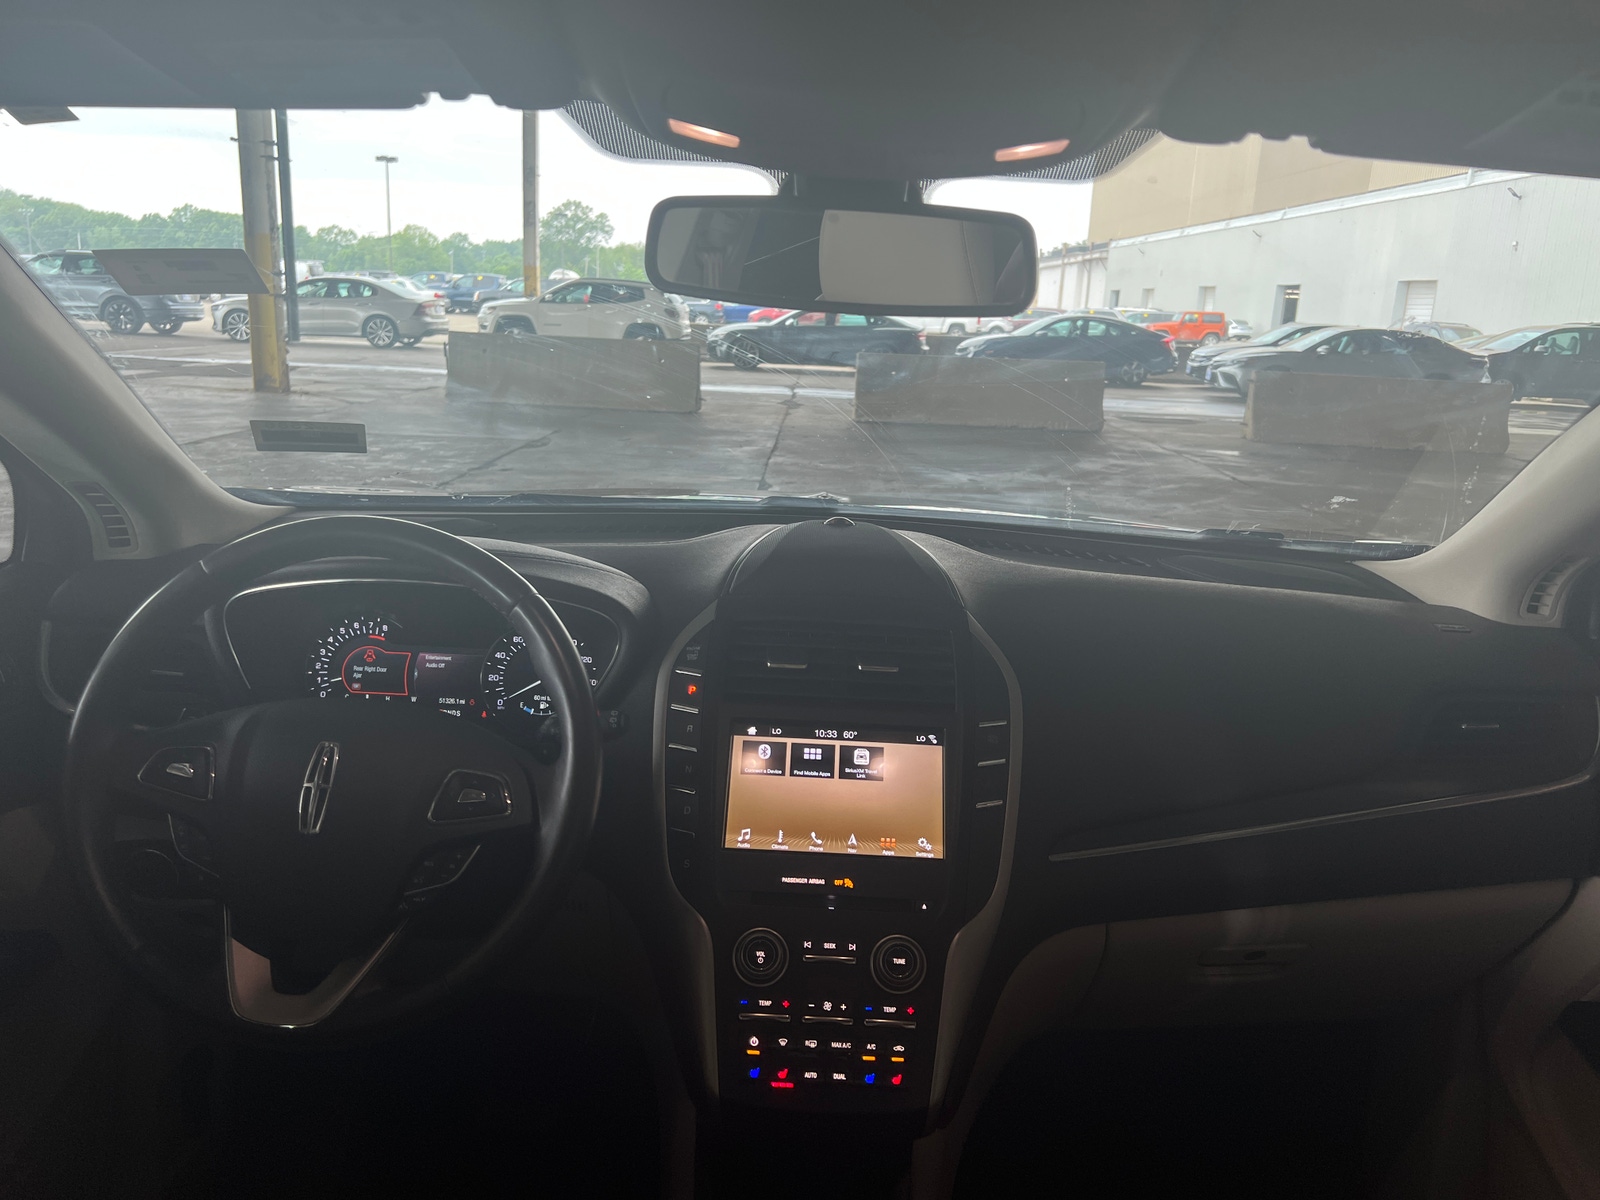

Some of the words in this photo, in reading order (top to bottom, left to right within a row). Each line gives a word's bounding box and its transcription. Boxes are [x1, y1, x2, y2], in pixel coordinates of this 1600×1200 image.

[688, 684, 697, 694] P
[686, 724, 694, 733] R
[814, 730, 838, 739] 10:33
[843, 730, 858, 739] 60°
[686, 765, 692, 773] N
[684, 806, 691, 814] D
